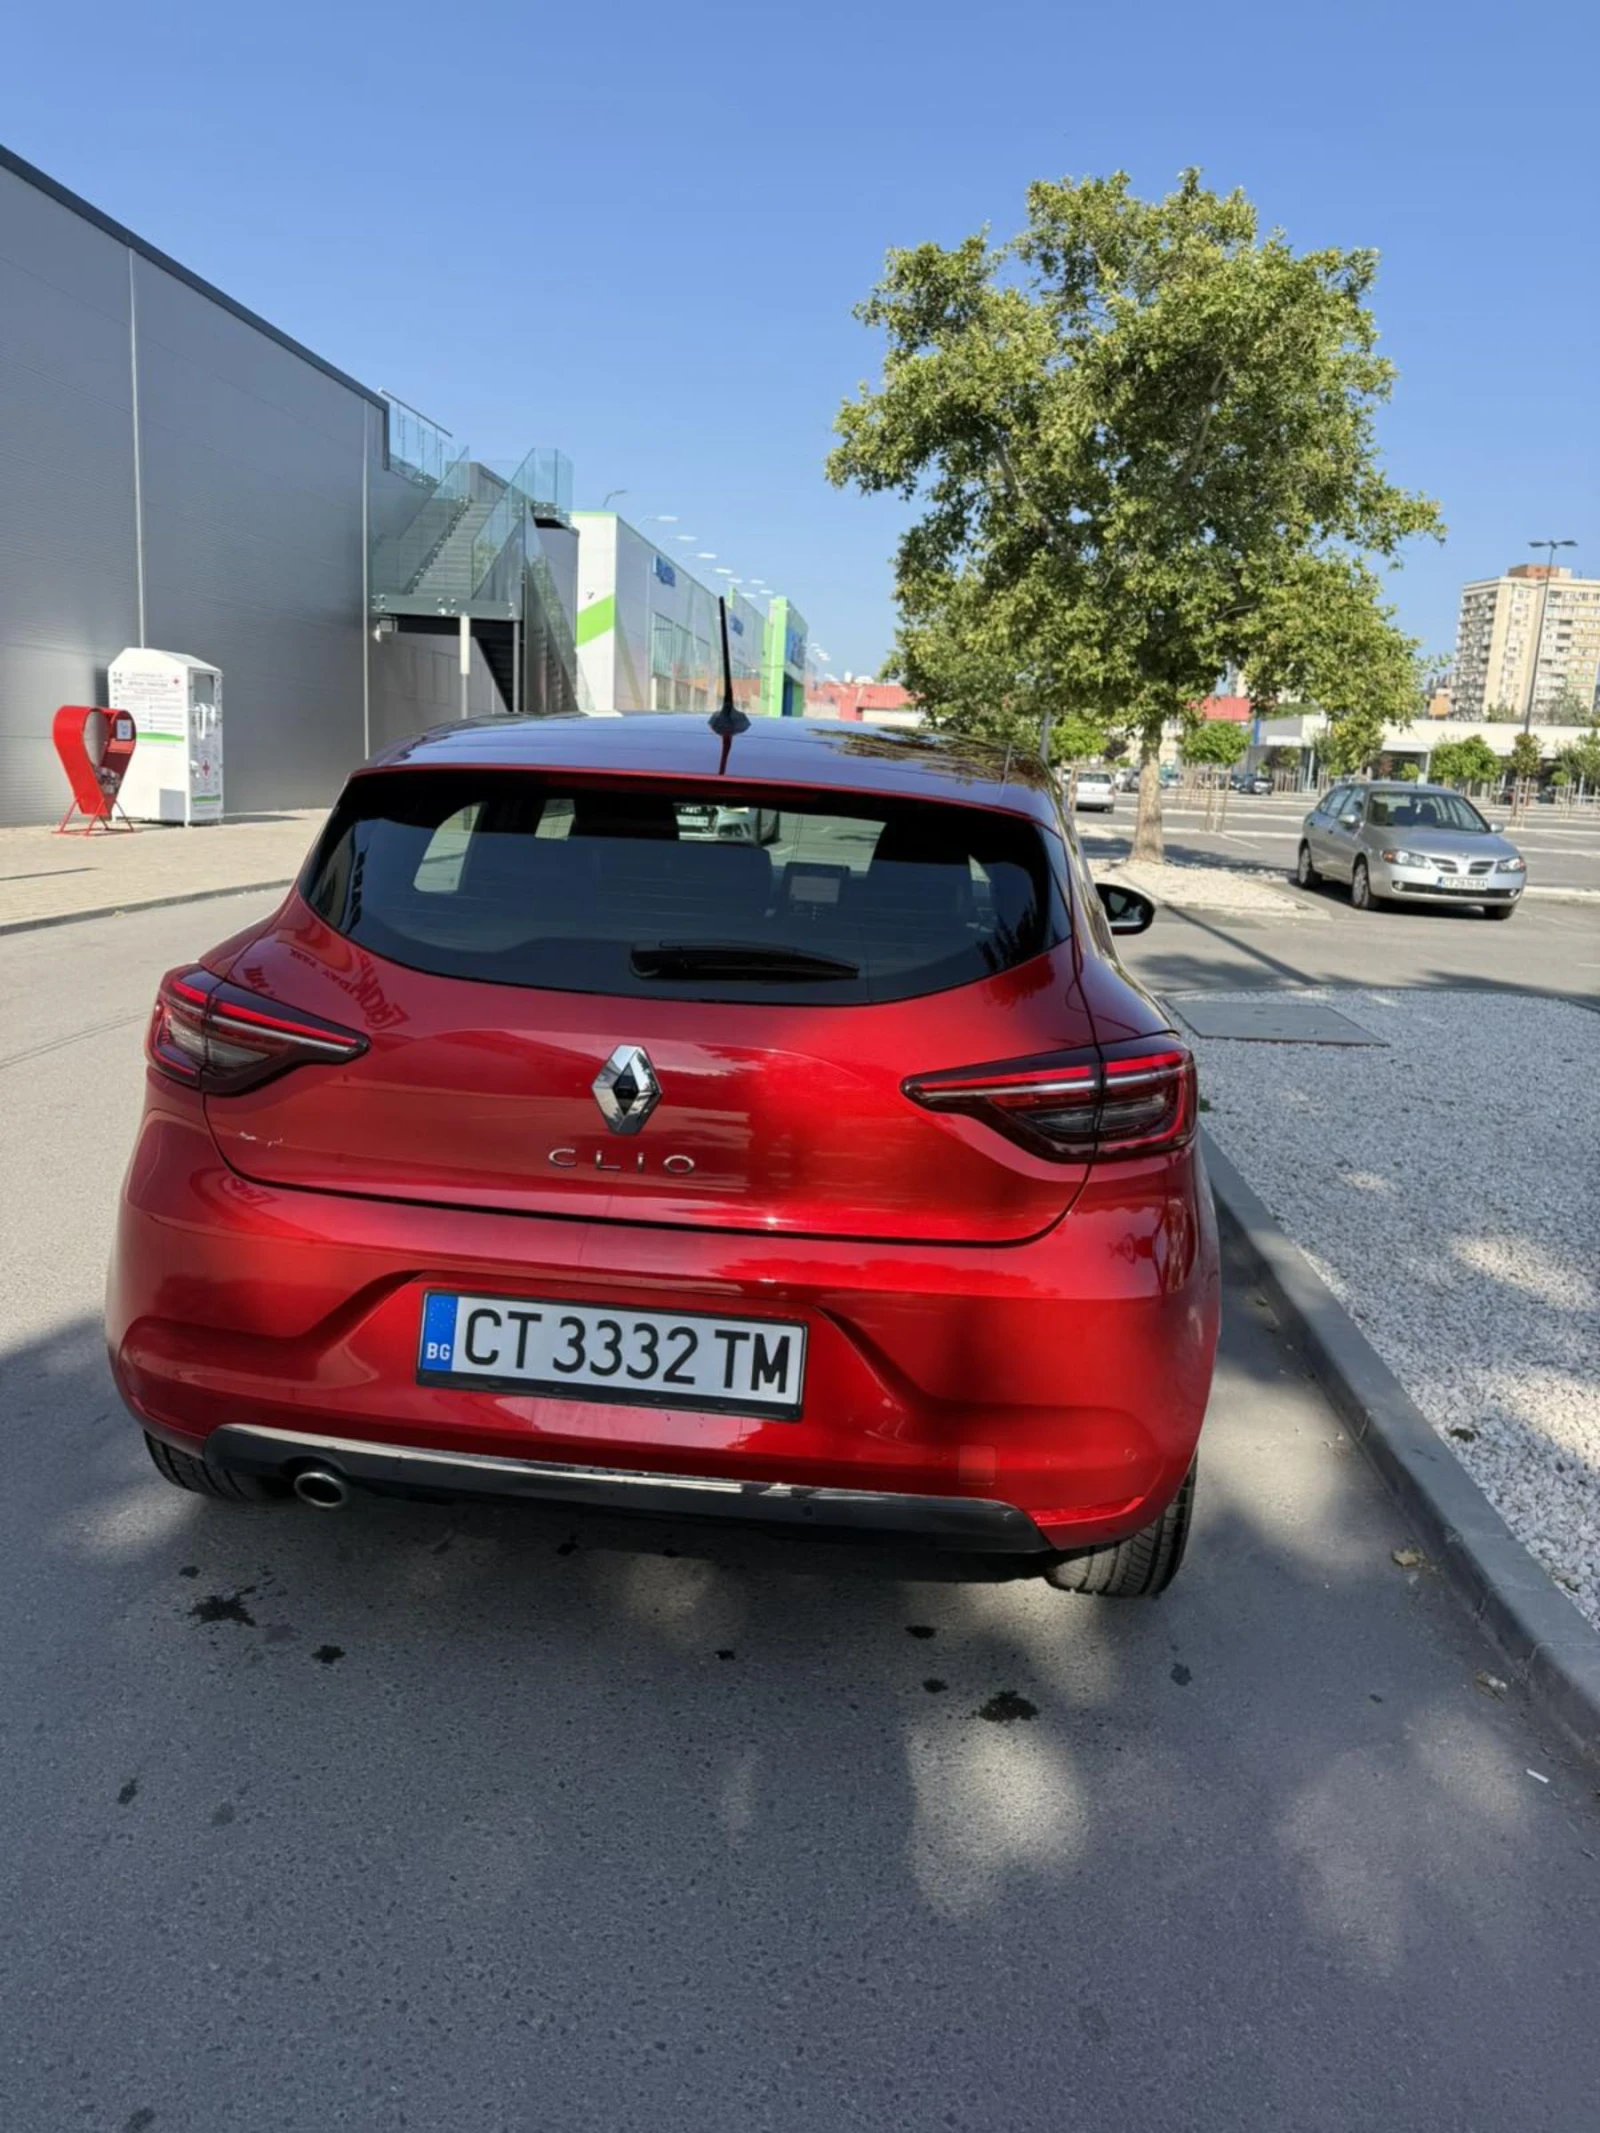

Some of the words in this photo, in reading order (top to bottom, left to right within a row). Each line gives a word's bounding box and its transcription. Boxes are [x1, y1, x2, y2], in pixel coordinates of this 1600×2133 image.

[548, 1147, 695, 1174] CLIO
[426, 1341, 451, 1360] BG
[464, 1308, 543, 1369] CT
[552, 1316, 699, 1386] 3332
[714, 1328, 791, 1394] TM
